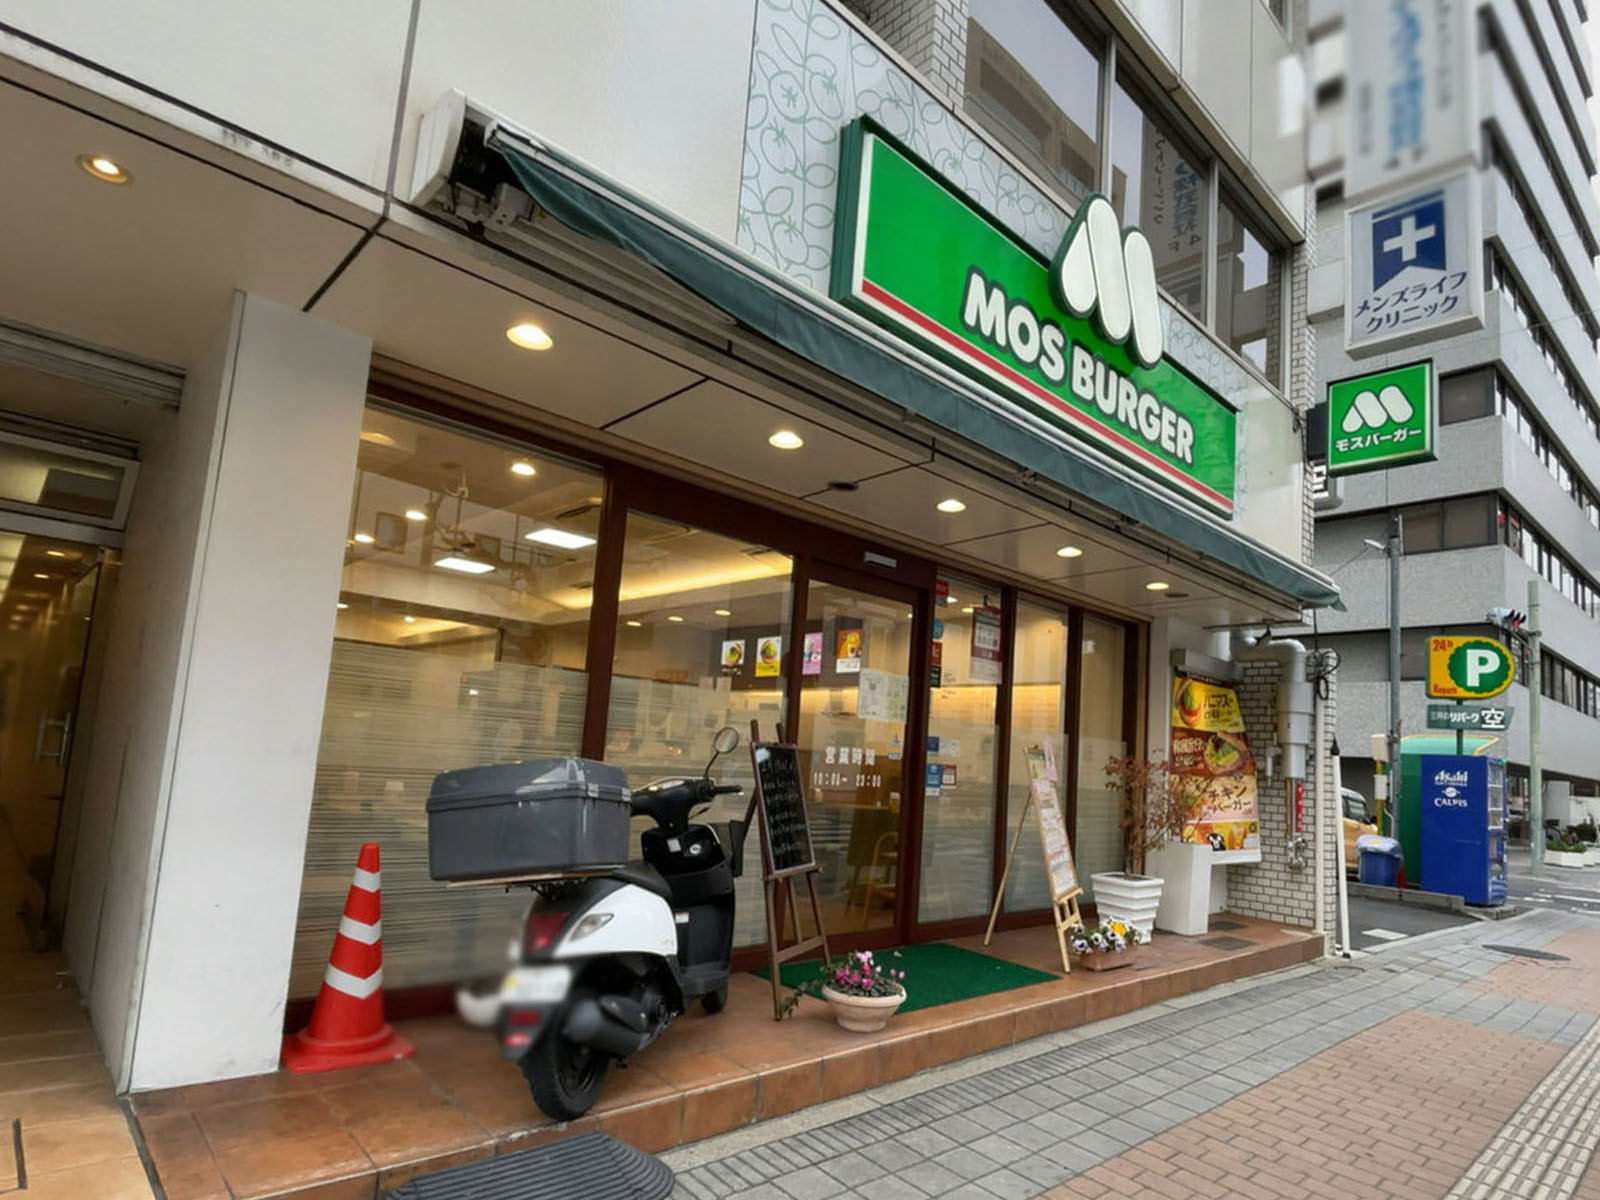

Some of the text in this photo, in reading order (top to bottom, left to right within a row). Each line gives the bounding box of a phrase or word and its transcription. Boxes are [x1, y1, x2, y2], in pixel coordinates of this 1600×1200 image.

[1355, 270, 1467, 317] メンズライフ
[1366, 295, 1460, 334] クリニック
[963, 273, 1193, 463] MOS BURGER
[1335, 427, 1422, 452] モスバーガー
[1466, 649, 1501, 687] P
[1481, 707, 1505, 729] 空
[1434, 769, 1468, 782] Asahi
[1208, 786, 1248, 802] チキン
[1434, 797, 1468, 808] CALPIS
